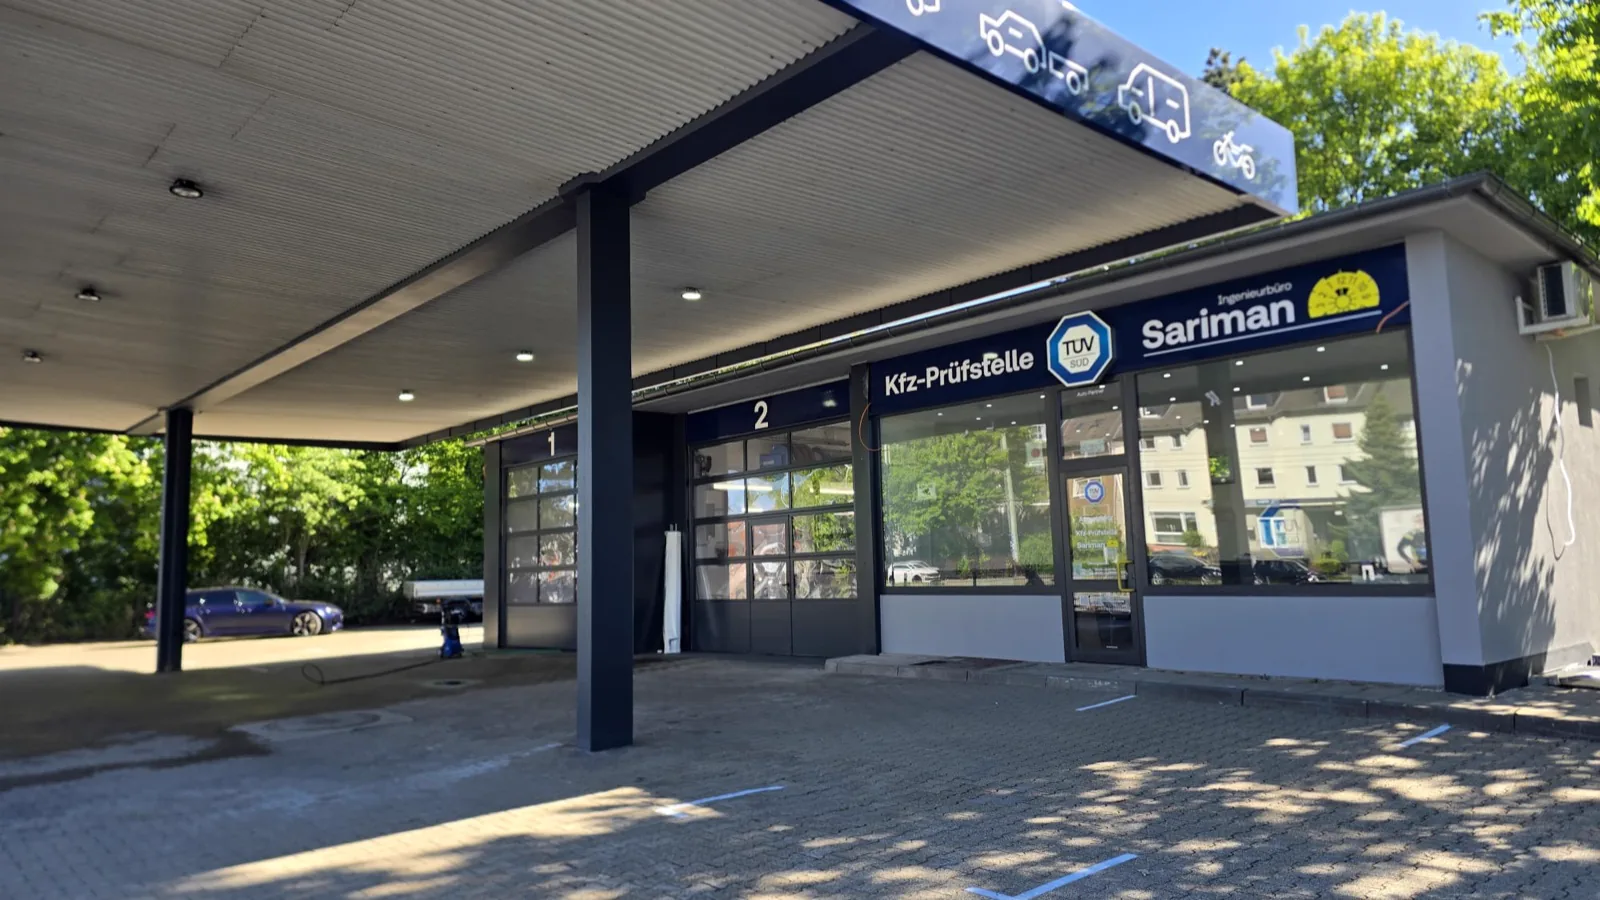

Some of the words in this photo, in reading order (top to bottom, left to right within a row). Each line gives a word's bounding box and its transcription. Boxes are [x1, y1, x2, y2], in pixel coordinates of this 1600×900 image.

[1217, 282, 1293, 306] Ingenieurbüro
[1142, 299, 1296, 350] Sariman
[885, 349, 1035, 397] Kfz-Prüfstelle
[753, 400, 769, 430] 2
[547, 431, 555, 457] 1
